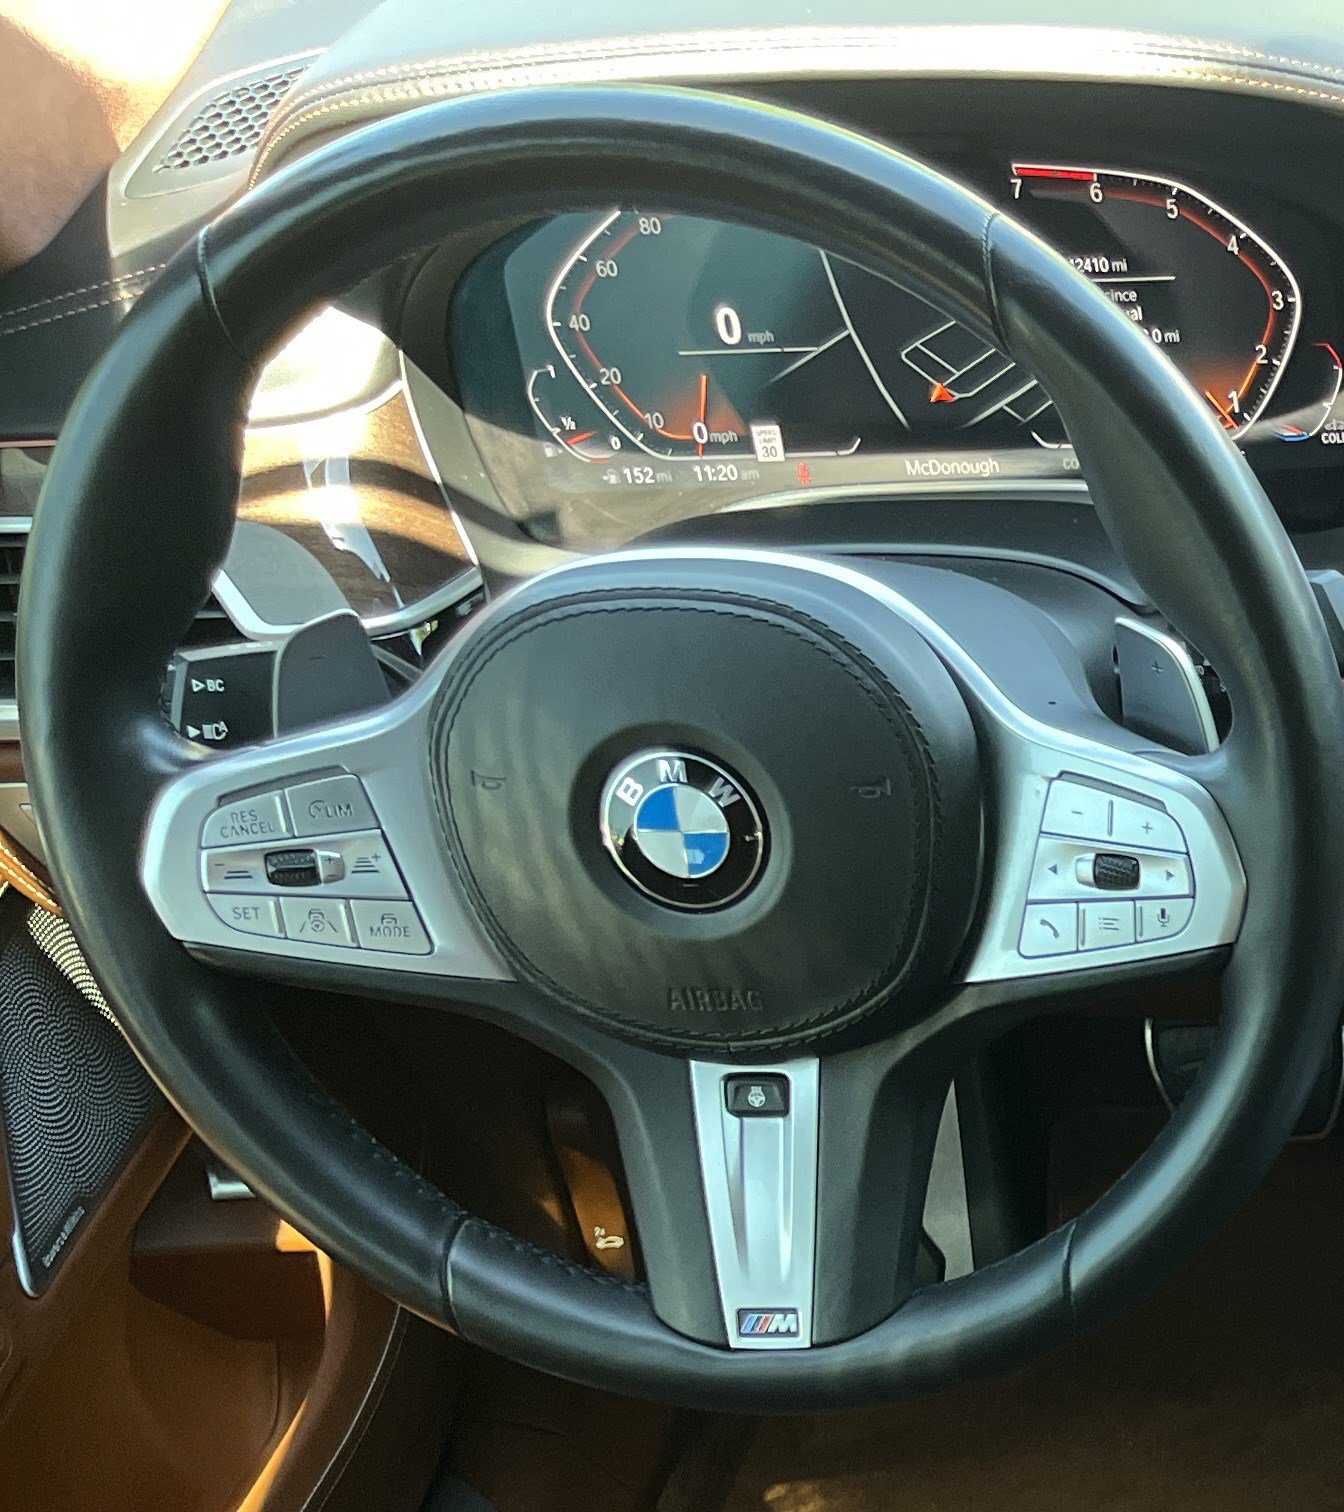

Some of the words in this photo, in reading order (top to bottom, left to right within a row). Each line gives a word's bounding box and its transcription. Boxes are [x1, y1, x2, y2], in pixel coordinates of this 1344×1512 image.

[1010, 178, 1022, 200] 7
[1089, 181, 1104, 203] 6
[1165, 199, 1180, 220] 5
[638, 216, 662, 236] 80
[1226, 234, 1240, 256] 4
[595, 259, 619, 278] 60
[1111, 258, 1128, 272] mi
[1271, 290, 1285, 311] 3
[568, 312, 591, 332] 40
[714, 305, 743, 346] 0
[747, 329, 775, 345] mph
[1164, 329, 1180, 343] mi
[1253, 344, 1269, 364] 2
[599, 366, 622, 386] 20
[1226, 389, 1241, 414] 1
[643, 411, 665, 430] 10
[609, 436, 622, 451] 0
[692, 422, 709, 445] 0
[709, 429, 739, 444] mph
[761, 445, 778, 458] 30
[622, 467, 656, 485] 152
[656, 470, 673, 484] mi
[692, 463, 739, 483] 11:20
[740, 469, 761, 482] am
[904, 457, 1000, 478] McDonough
[205, 679, 225, 692] BC
[615, 758, 742, 808] BMW
[230, 809, 258, 823] RES
[325, 802, 354, 819] LIM
[219, 823, 276, 839] CANCEL
[232, 906, 260, 921] SET
[369, 925, 412, 938] MODE
